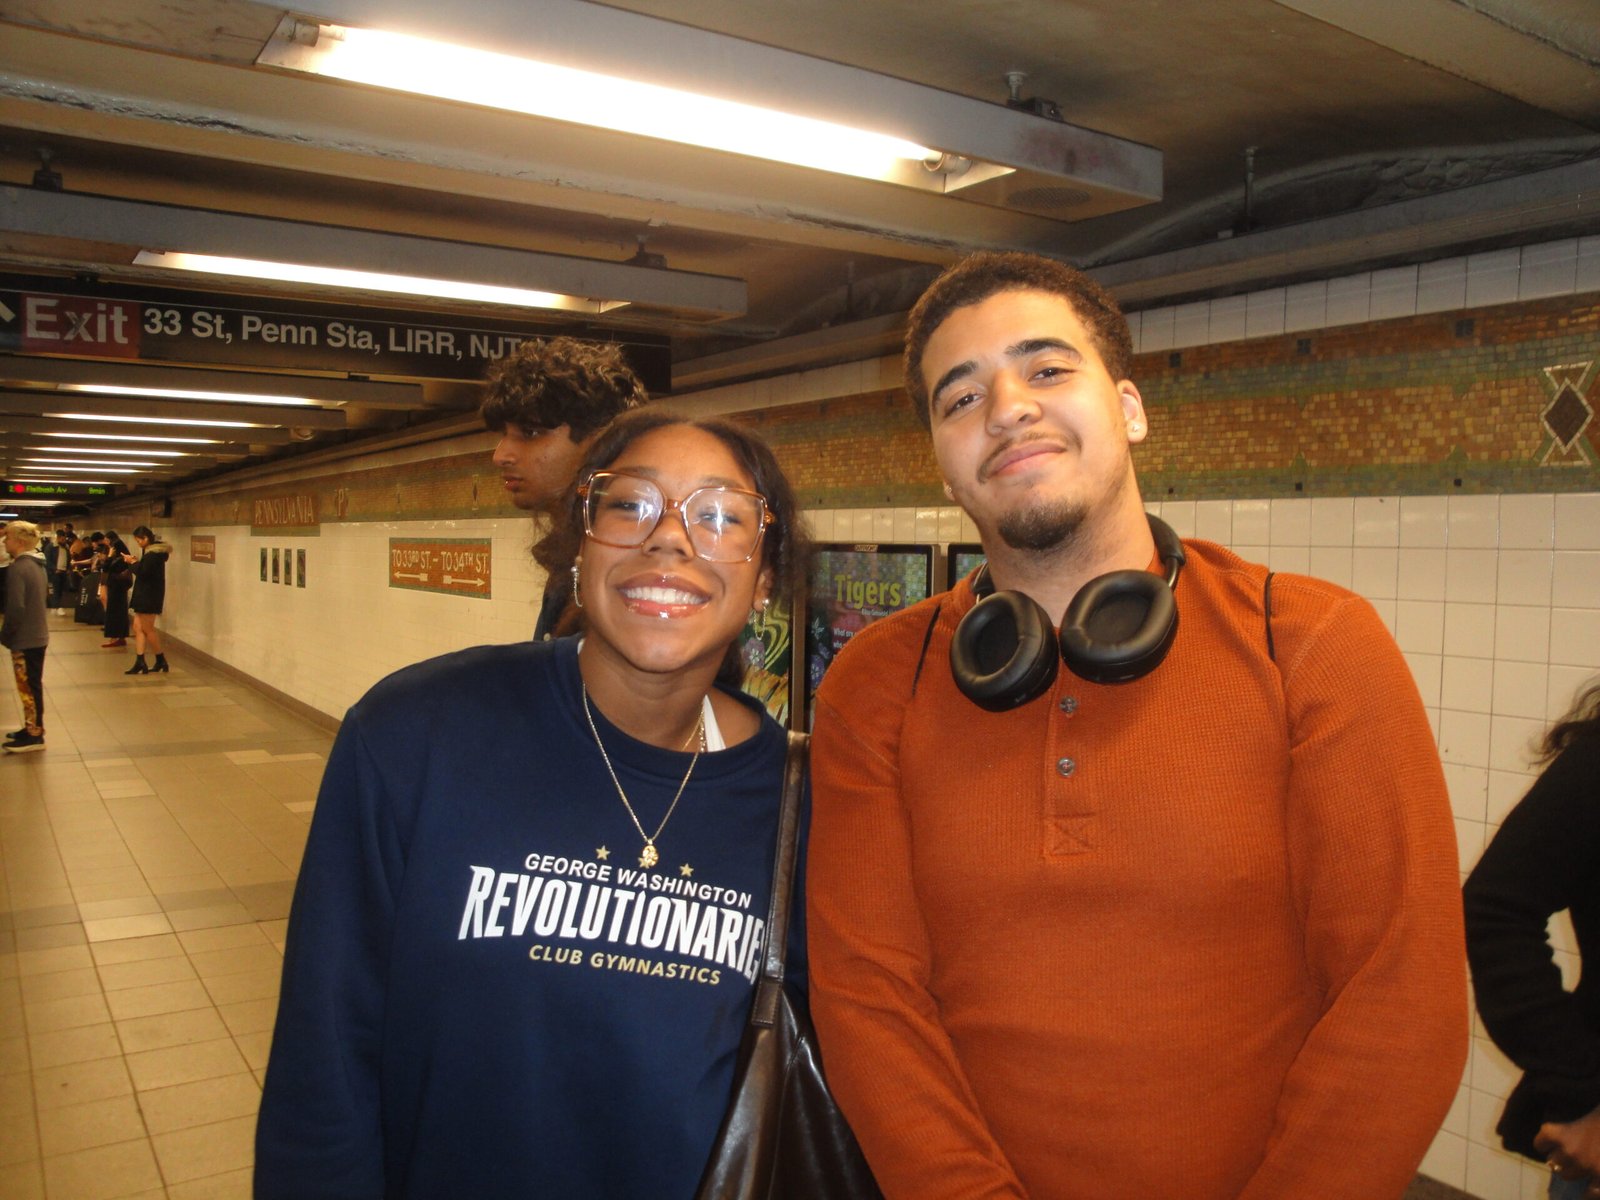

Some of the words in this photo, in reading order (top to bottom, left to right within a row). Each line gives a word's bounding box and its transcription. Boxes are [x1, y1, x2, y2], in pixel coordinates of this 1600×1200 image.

[26, 297, 129, 344] Exit
[143, 307, 182, 336] 33
[191, 310, 232, 344] St,
[242, 315, 317, 345] Penn
[326, 321, 380, 355] Sta,
[388, 327, 462, 361] LIRR,
[392, 549, 402, 568] TO
[420, 550, 432, 569] ST.
[440, 551, 453, 571] TO
[475, 553, 490, 575] ST.
[834, 574, 901, 609] Tigers
[524, 852, 612, 882] GEORGE
[617, 867, 753, 909] WASHINGTON
[457, 864, 765, 985] REVOLUTIONARIE
[528, 944, 583, 966] CLUB
[590, 951, 722, 986] GYMNASTICS
